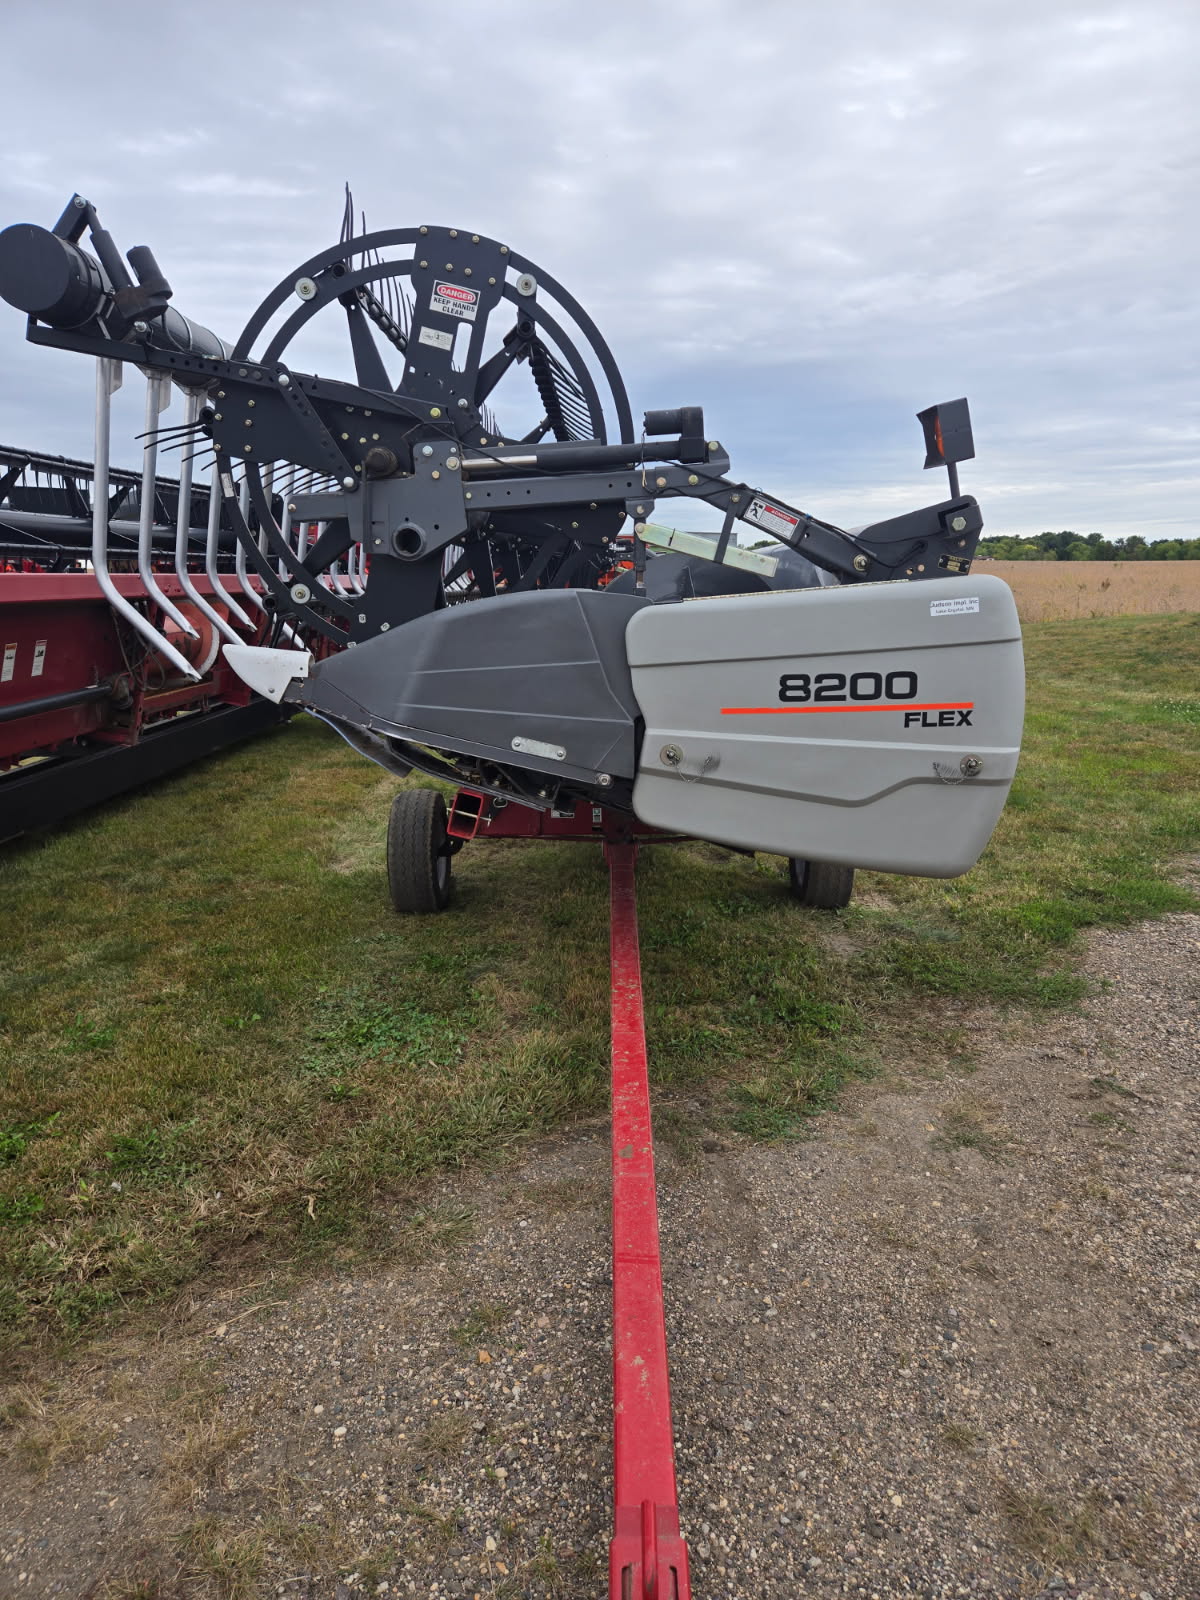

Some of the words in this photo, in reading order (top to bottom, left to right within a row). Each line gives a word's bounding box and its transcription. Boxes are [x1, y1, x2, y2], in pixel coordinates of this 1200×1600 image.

[440, 287, 473, 301] DANGER
[433, 296, 451, 306] KEEP
[453, 301, 476, 313] HANDS
[442, 306, 464, 317] CLEAR
[779, 671, 918, 702] 8200
[904, 710, 973, 728] FLEX
